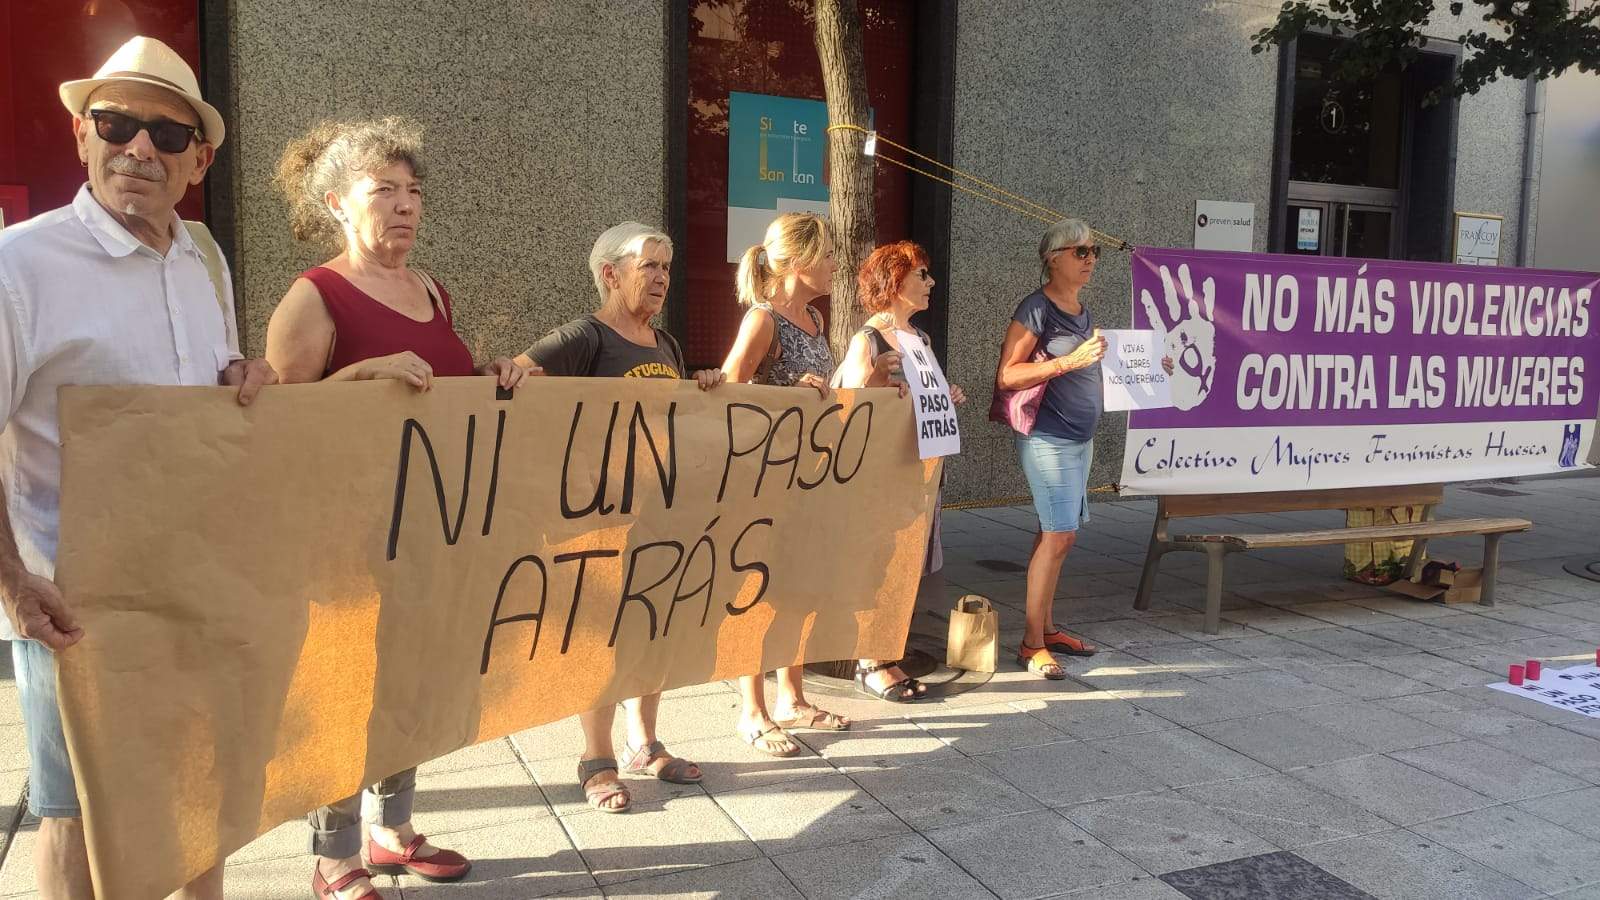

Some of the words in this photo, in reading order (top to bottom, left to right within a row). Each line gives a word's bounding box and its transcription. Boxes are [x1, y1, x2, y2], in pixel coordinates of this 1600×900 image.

[760, 116, 772, 131] Si
[793, 120, 807, 135] te
[1242, 273, 1299, 331] NO
[1313, 262, 1396, 334] MÁS
[1409, 280, 1592, 338] VIOLENCIAS
[912, 349, 928, 366] NI
[1122, 344, 1145, 353] VIVAS
[1119, 360, 1124, 368] Y
[1126, 359, 1151, 369] LIBRES
[920, 370, 939, 389] UN
[1108, 375, 1123, 385] NOS
[1125, 373, 1165, 385] QUEREMOS
[1236, 353, 1378, 410] CONTRA
[1387, 355, 1446, 409] LAS
[1454, 356, 1585, 407] MUJERES
[919, 394, 949, 413] PASO
[921, 414, 957, 439] ATRÁS
[559, 401, 677, 520] UN
[716, 401, 873, 504] PASO
[1134, 436, 1238, 475] Colectivo
[1251, 434, 1351, 485] Mujeres
[1365, 434, 1473, 464] Feministas
[1485, 430, 1548, 458] Huesca
[479, 515, 774, 676] ATRÁS
